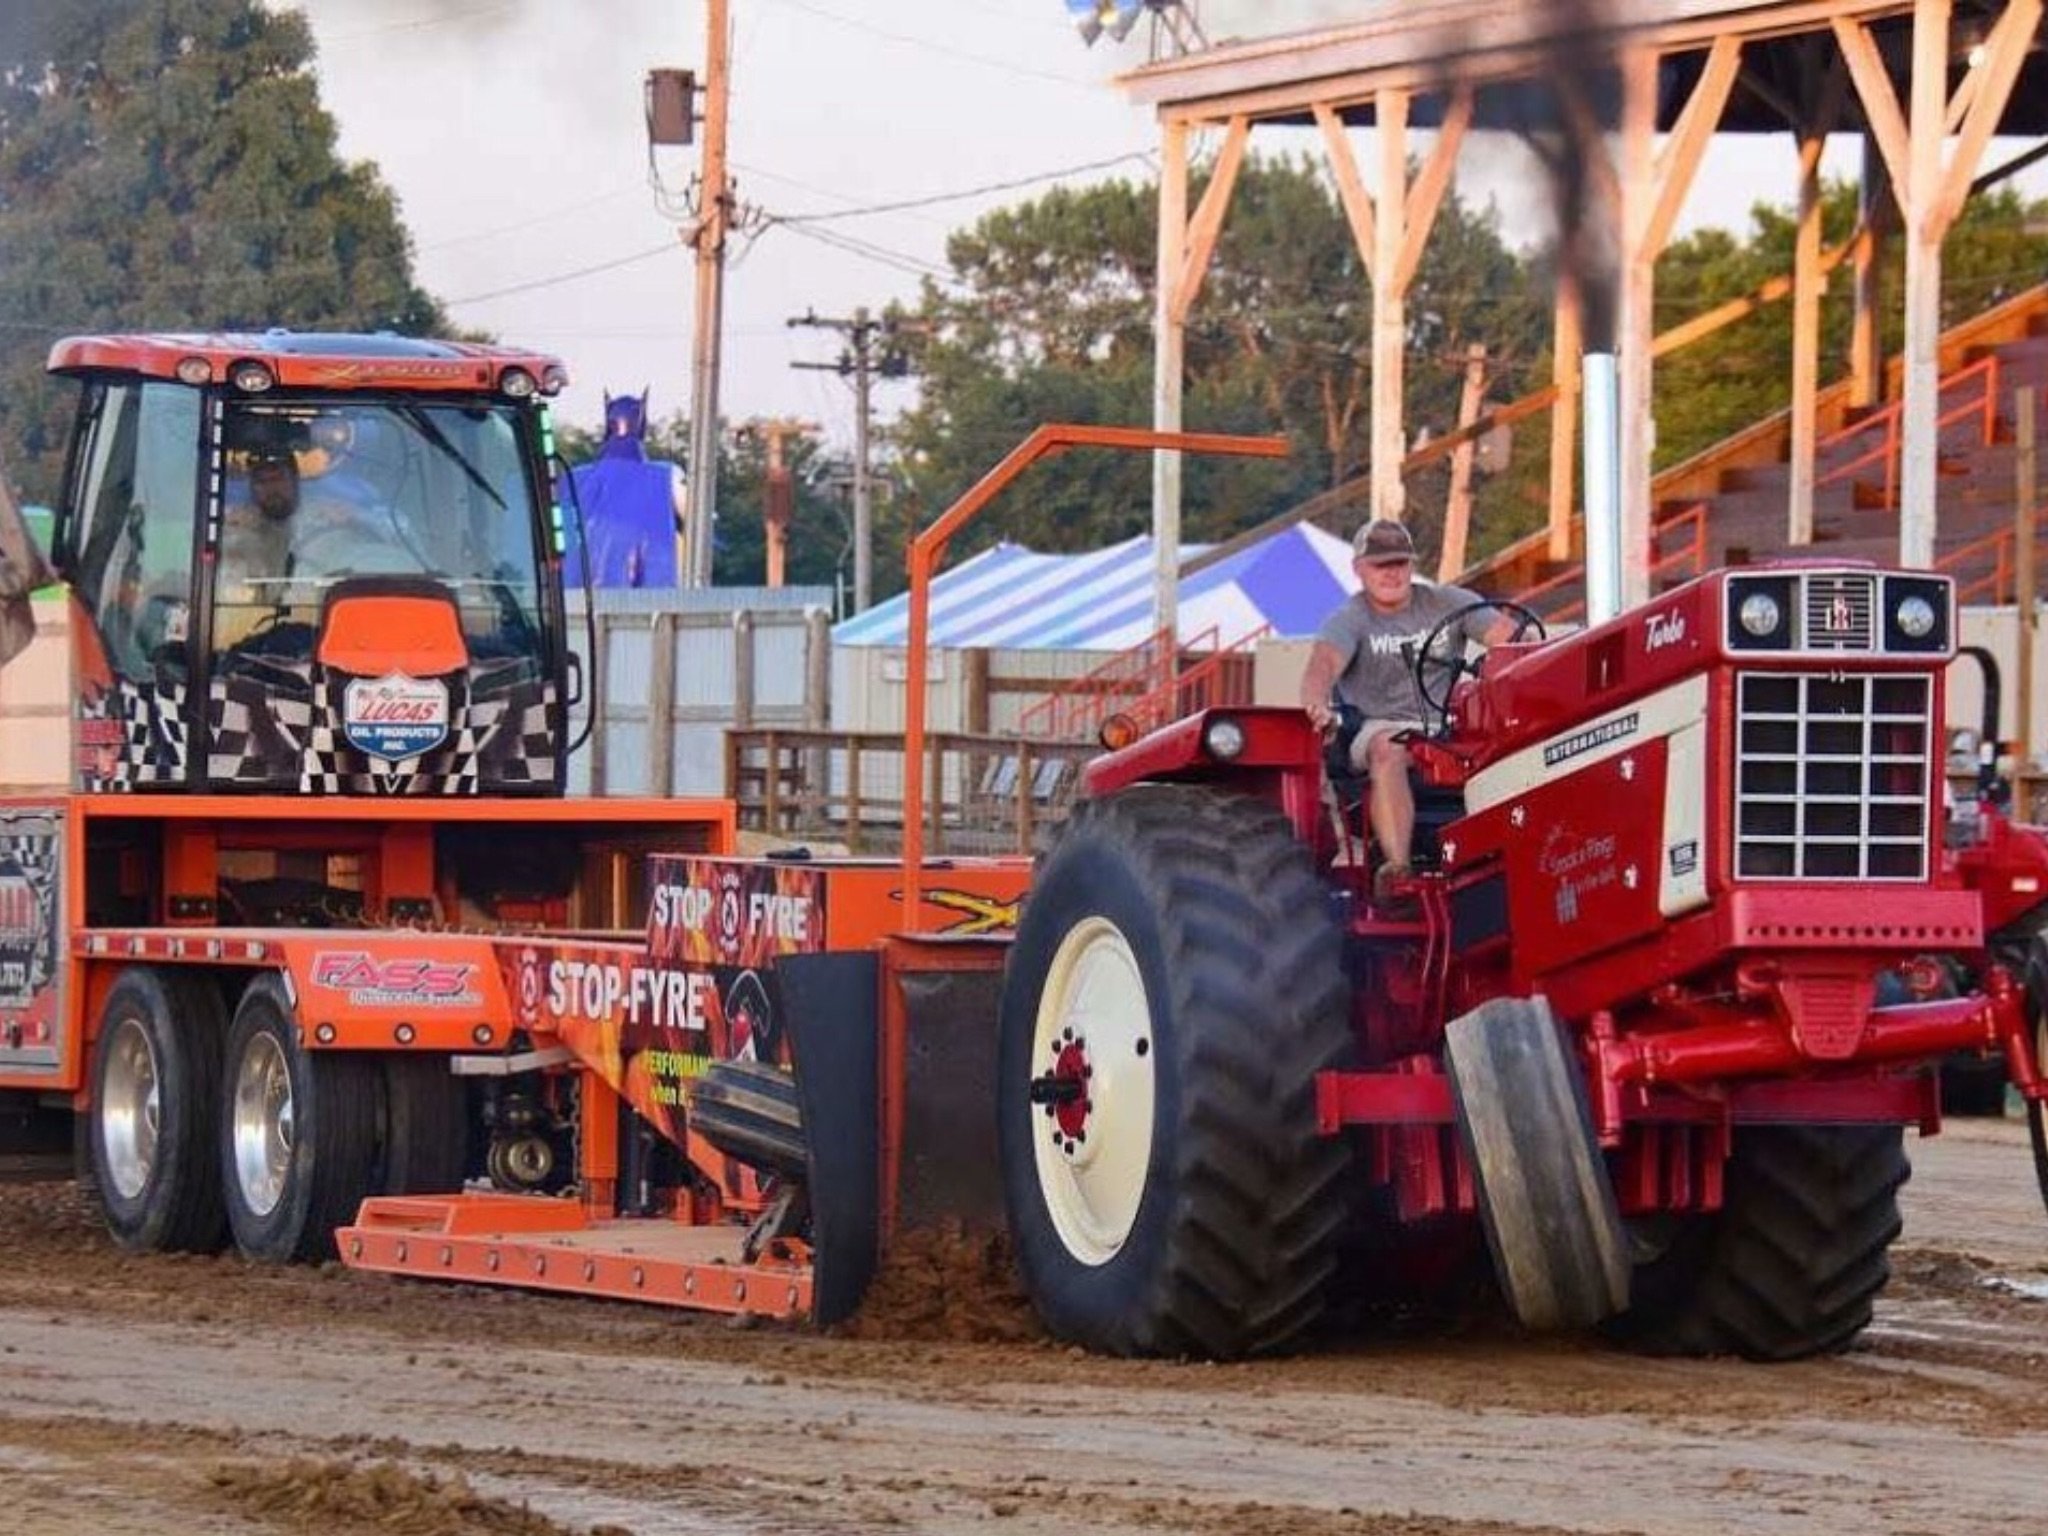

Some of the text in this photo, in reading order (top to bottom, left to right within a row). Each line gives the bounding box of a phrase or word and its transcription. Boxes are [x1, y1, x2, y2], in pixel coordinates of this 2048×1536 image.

[1645, 606, 1685, 653] Turbo
[351, 726, 441, 738] OIL PRODUCTS
[356, 701, 438, 721] LUCAS
[1545, 713, 1638, 765] INTERNATIONAL
[654, 884, 812, 941] STOP FYRE
[314, 951, 468, 997] FASS
